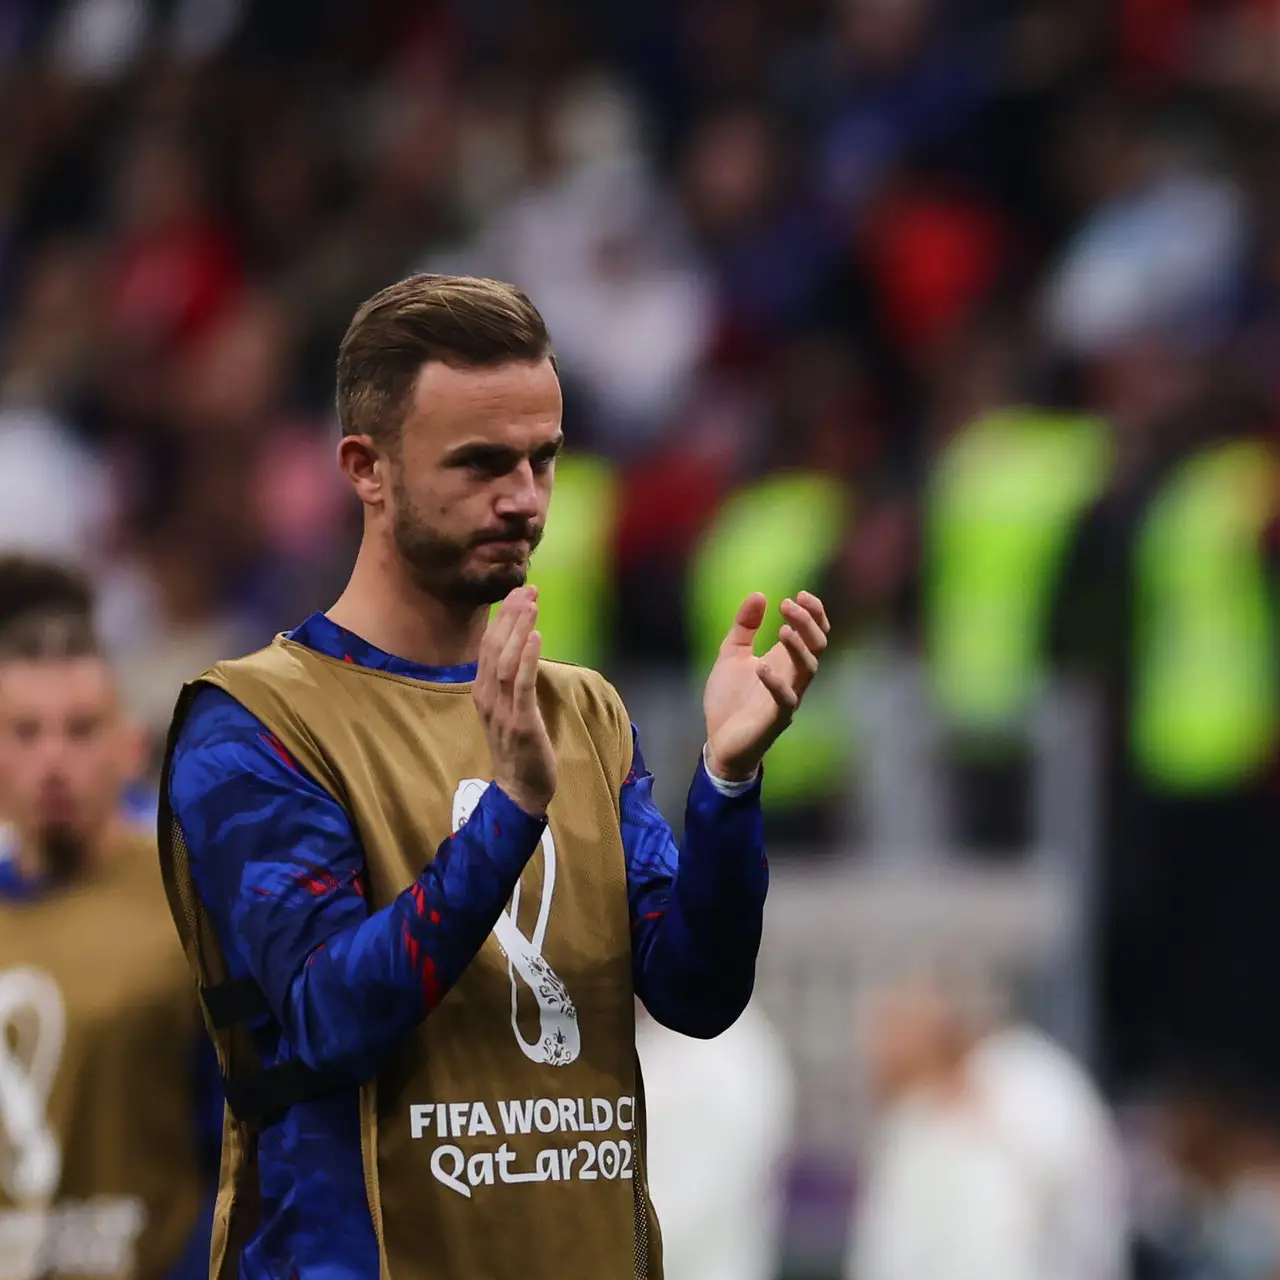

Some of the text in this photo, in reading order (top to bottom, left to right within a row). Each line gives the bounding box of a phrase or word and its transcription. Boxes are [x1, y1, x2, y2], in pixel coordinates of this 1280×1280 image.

[410, 1096, 636, 1138] FIFA WORLD C
[430, 1140, 633, 1198] Qatar202
